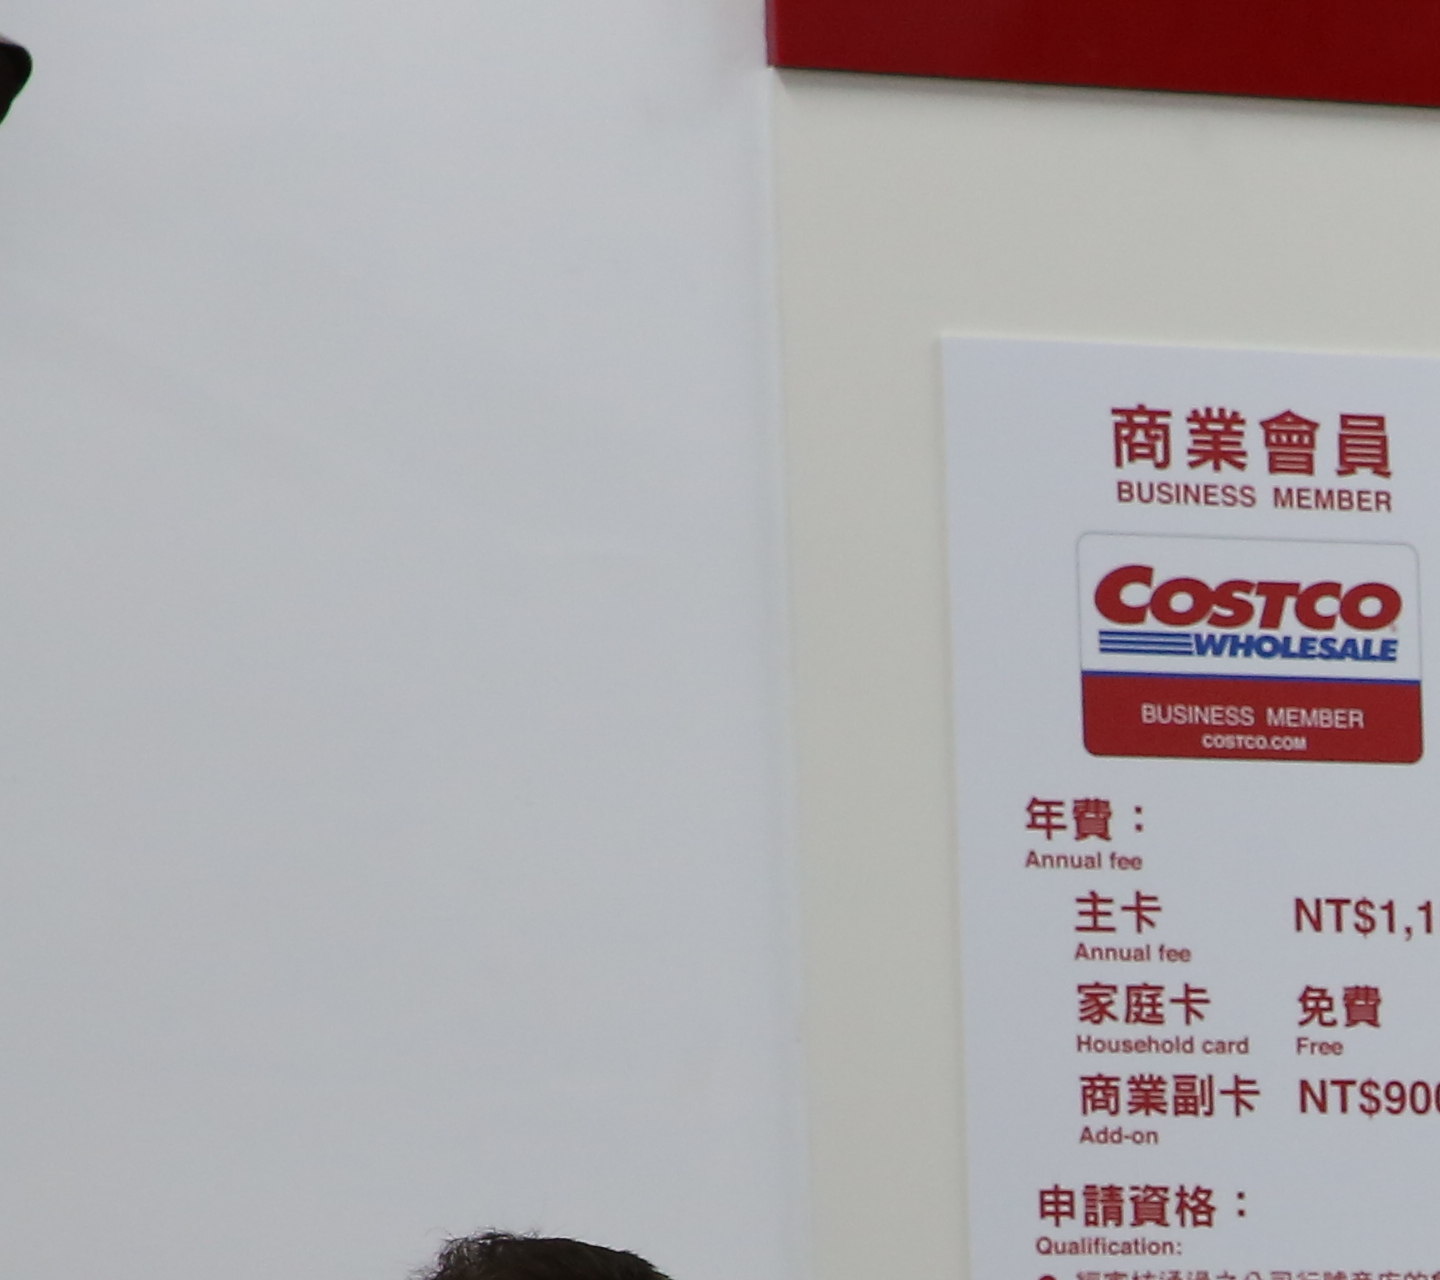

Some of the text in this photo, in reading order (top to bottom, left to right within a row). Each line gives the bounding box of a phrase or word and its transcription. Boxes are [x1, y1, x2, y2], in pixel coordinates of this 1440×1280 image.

[1110, 403, 1392, 479] 商業會員
[1116, 480, 1392, 513] BUSINESS MEMBER
[1094, 564, 1403, 631] COSTCO
[1193, 633, 1399, 663] WHOLESALE
[1140, 703, 1365, 730] BUSINESS MEMBER
[1201, 734, 1308, 752] COSTCO.COM
[1025, 796, 1143, 842] 年費：
[1024, 849, 1143, 871] Annual fee
[1074, 890, 1162, 934] 主卡
[1076, 981, 1382, 1029] 家庭卡 免費
[1076, 1034, 1344, 1057] Household card Free
[1079, 1072, 1261, 1118] 商業副卡
[1079, 1125, 1159, 1146] Add-on
[1038, 1183, 1246, 1228] 申請資格：
[1034, 1235, 1182, 1256] Qualification:
